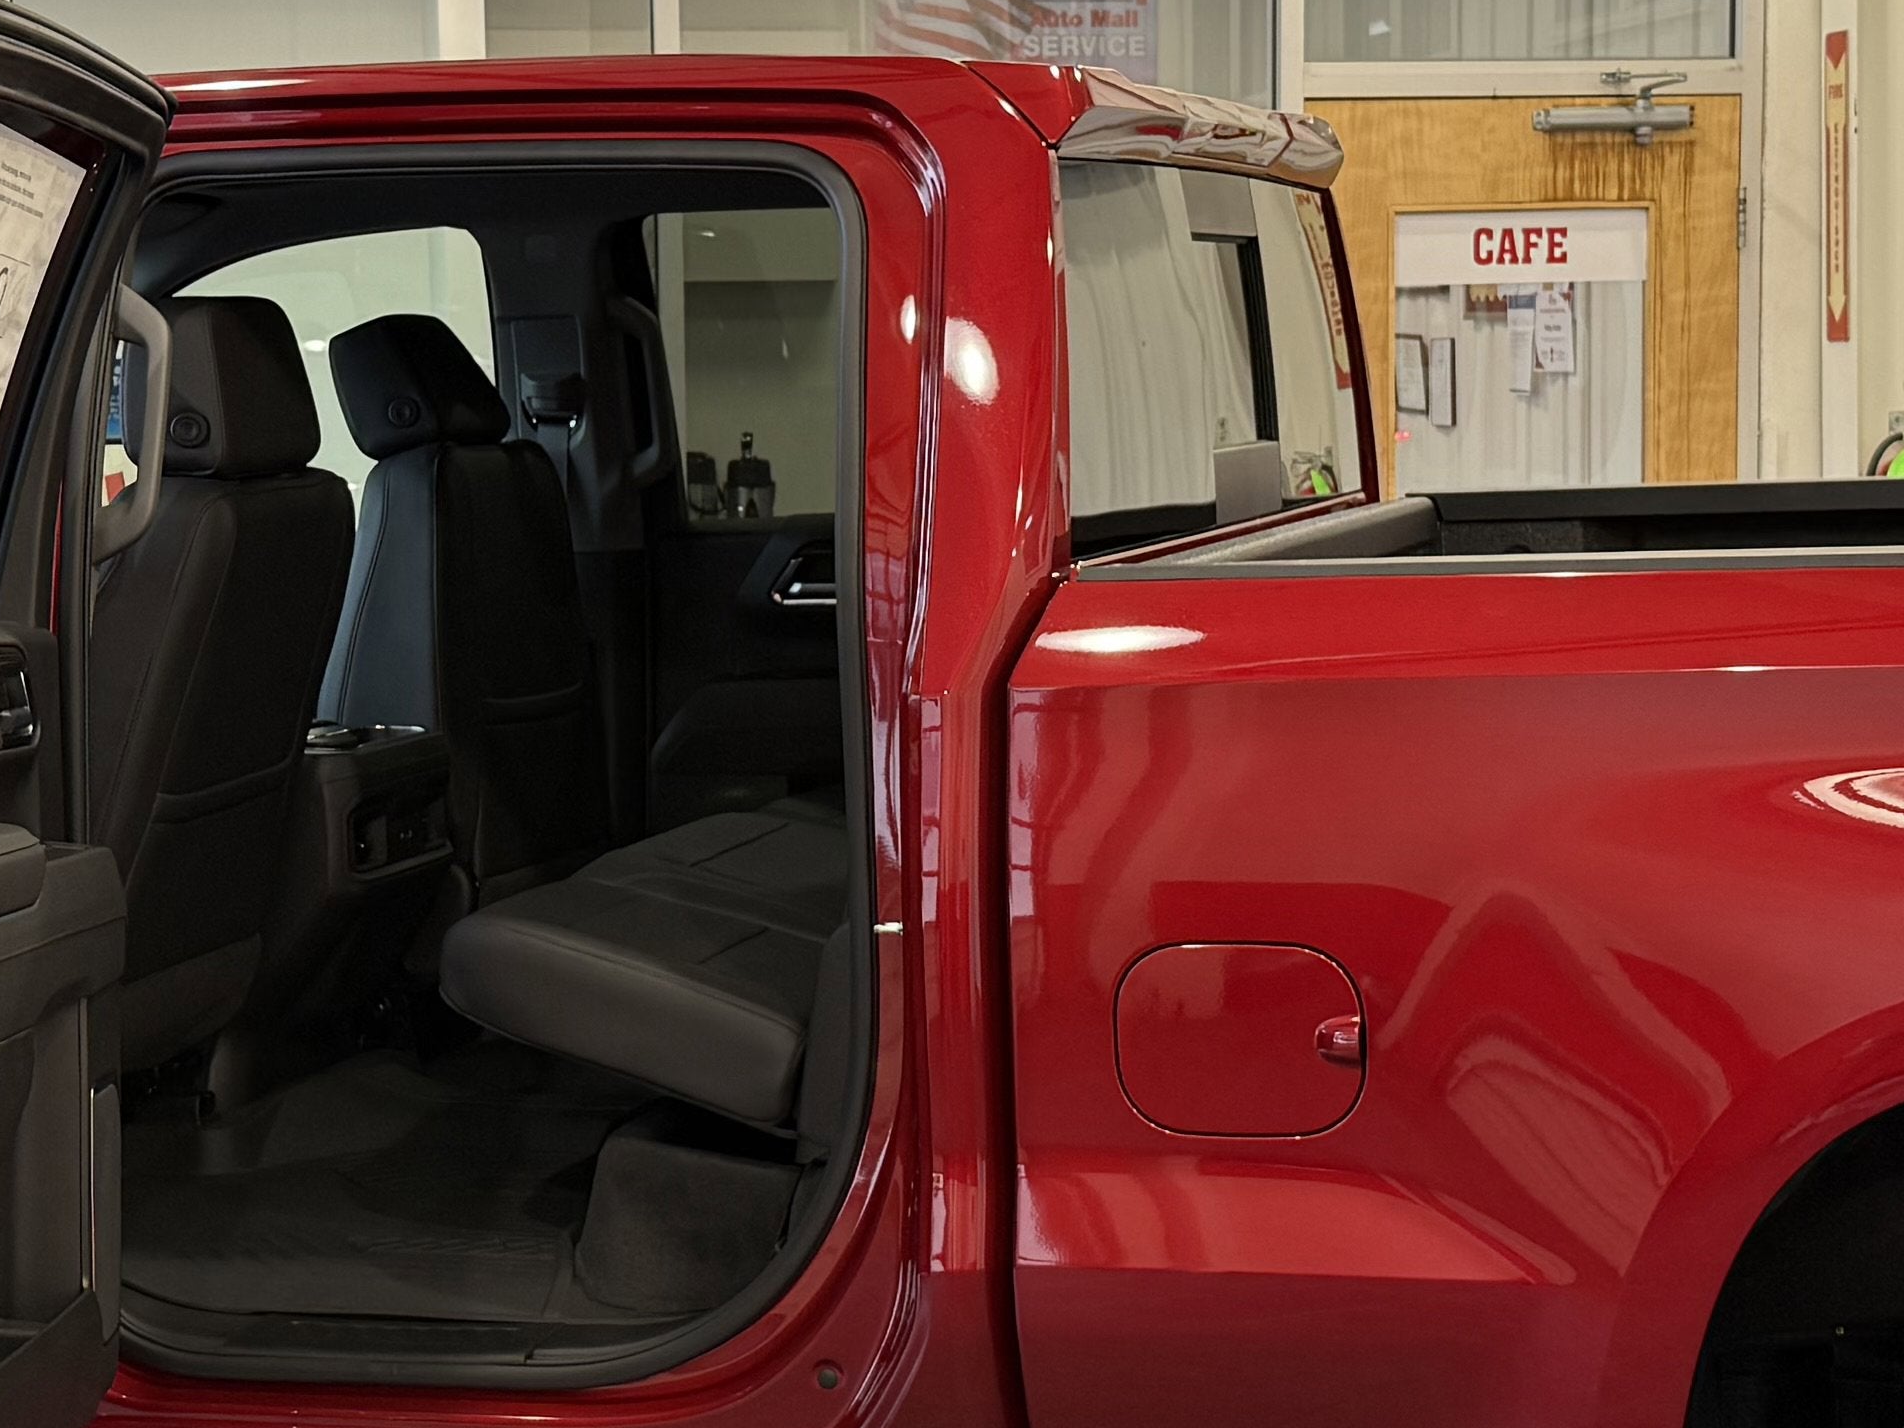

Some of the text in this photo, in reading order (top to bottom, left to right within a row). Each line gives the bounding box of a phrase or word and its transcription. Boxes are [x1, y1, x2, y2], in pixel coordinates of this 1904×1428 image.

[1033, 9, 1138, 28] Auto Mall
[1023, 35, 1146, 58] SERVICE
[1473, 227, 1568, 266] CAFE
